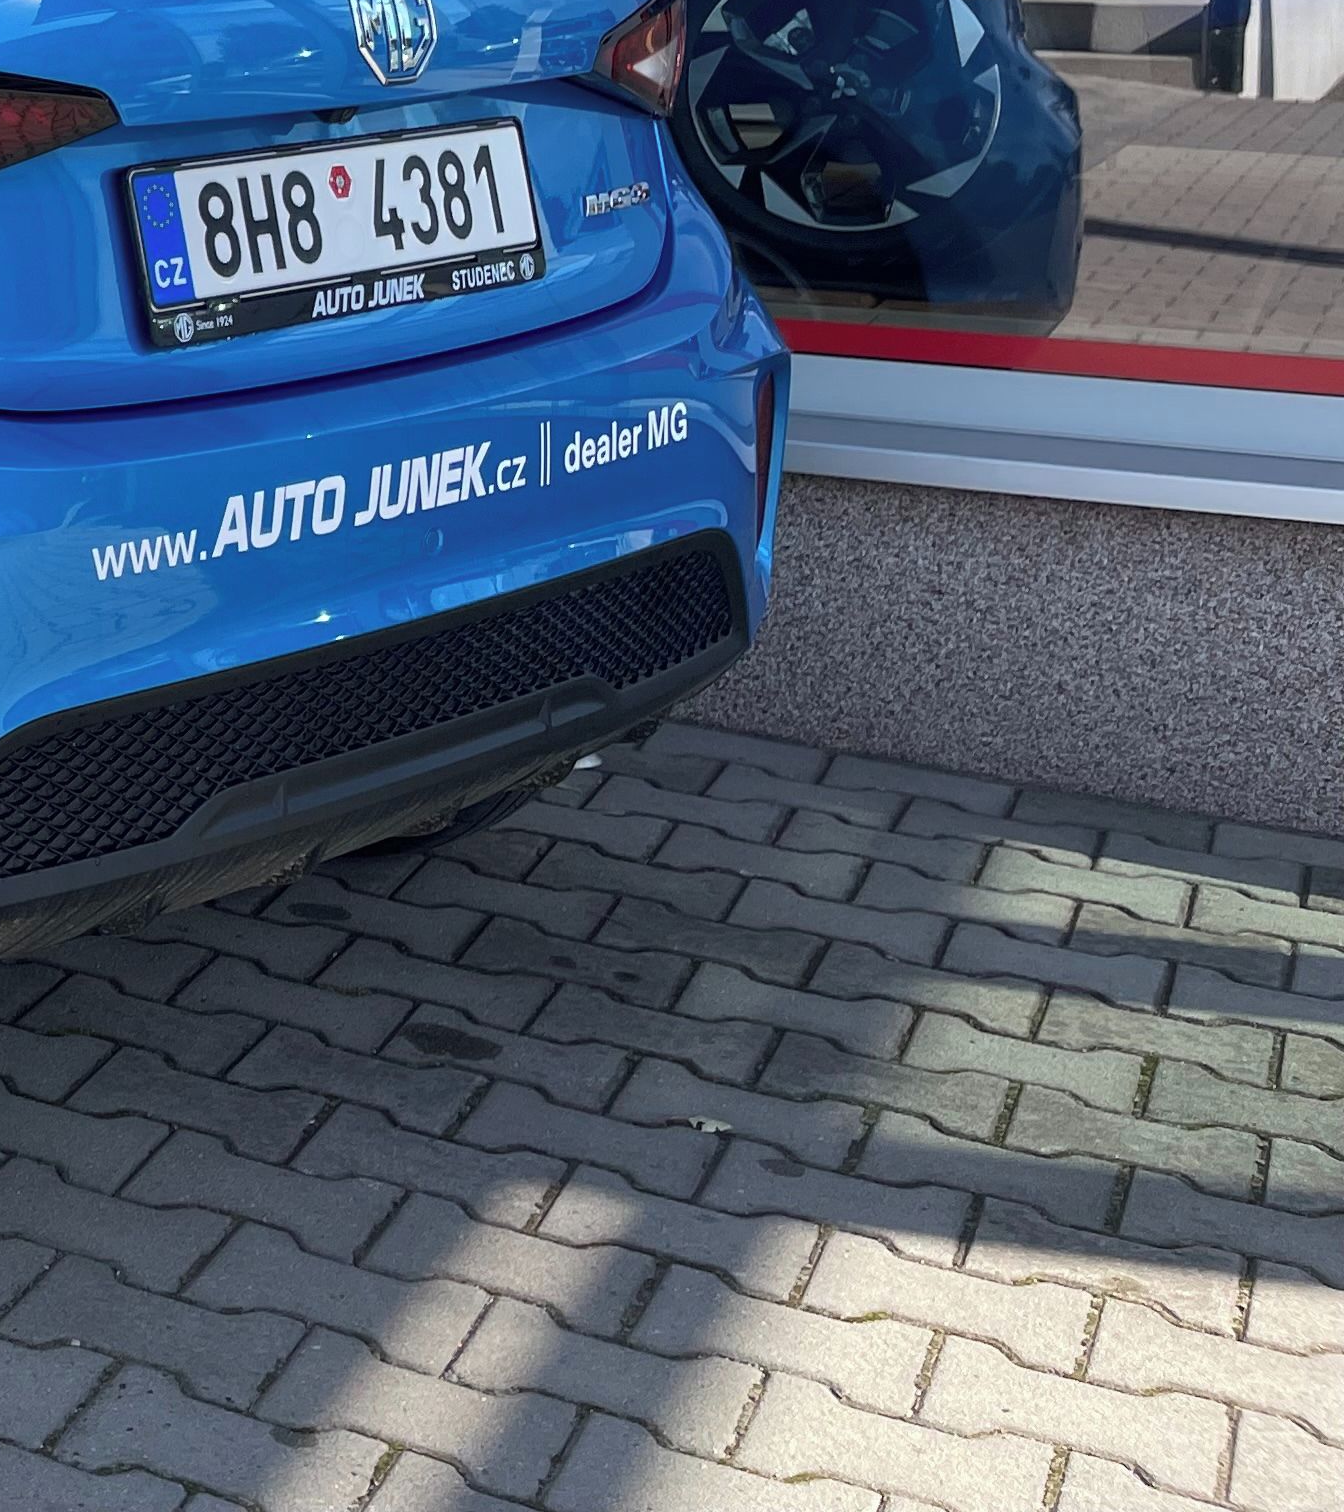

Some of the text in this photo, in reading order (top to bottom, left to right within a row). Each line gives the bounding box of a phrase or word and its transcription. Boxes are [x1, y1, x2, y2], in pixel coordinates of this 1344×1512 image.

[197, 144, 506, 278] 8H8 4381
[585, 181, 649, 217] MG3
[154, 256, 188, 289] CZ
[519, 253, 535, 280] MG
[312, 261, 515, 318] AUTO JUNEK STUDENEC
[174, 313, 194, 342] MG
[216, 315, 233, 327] 1924
[564, 422, 643, 474] dealer
[647, 402, 688, 447] MG
